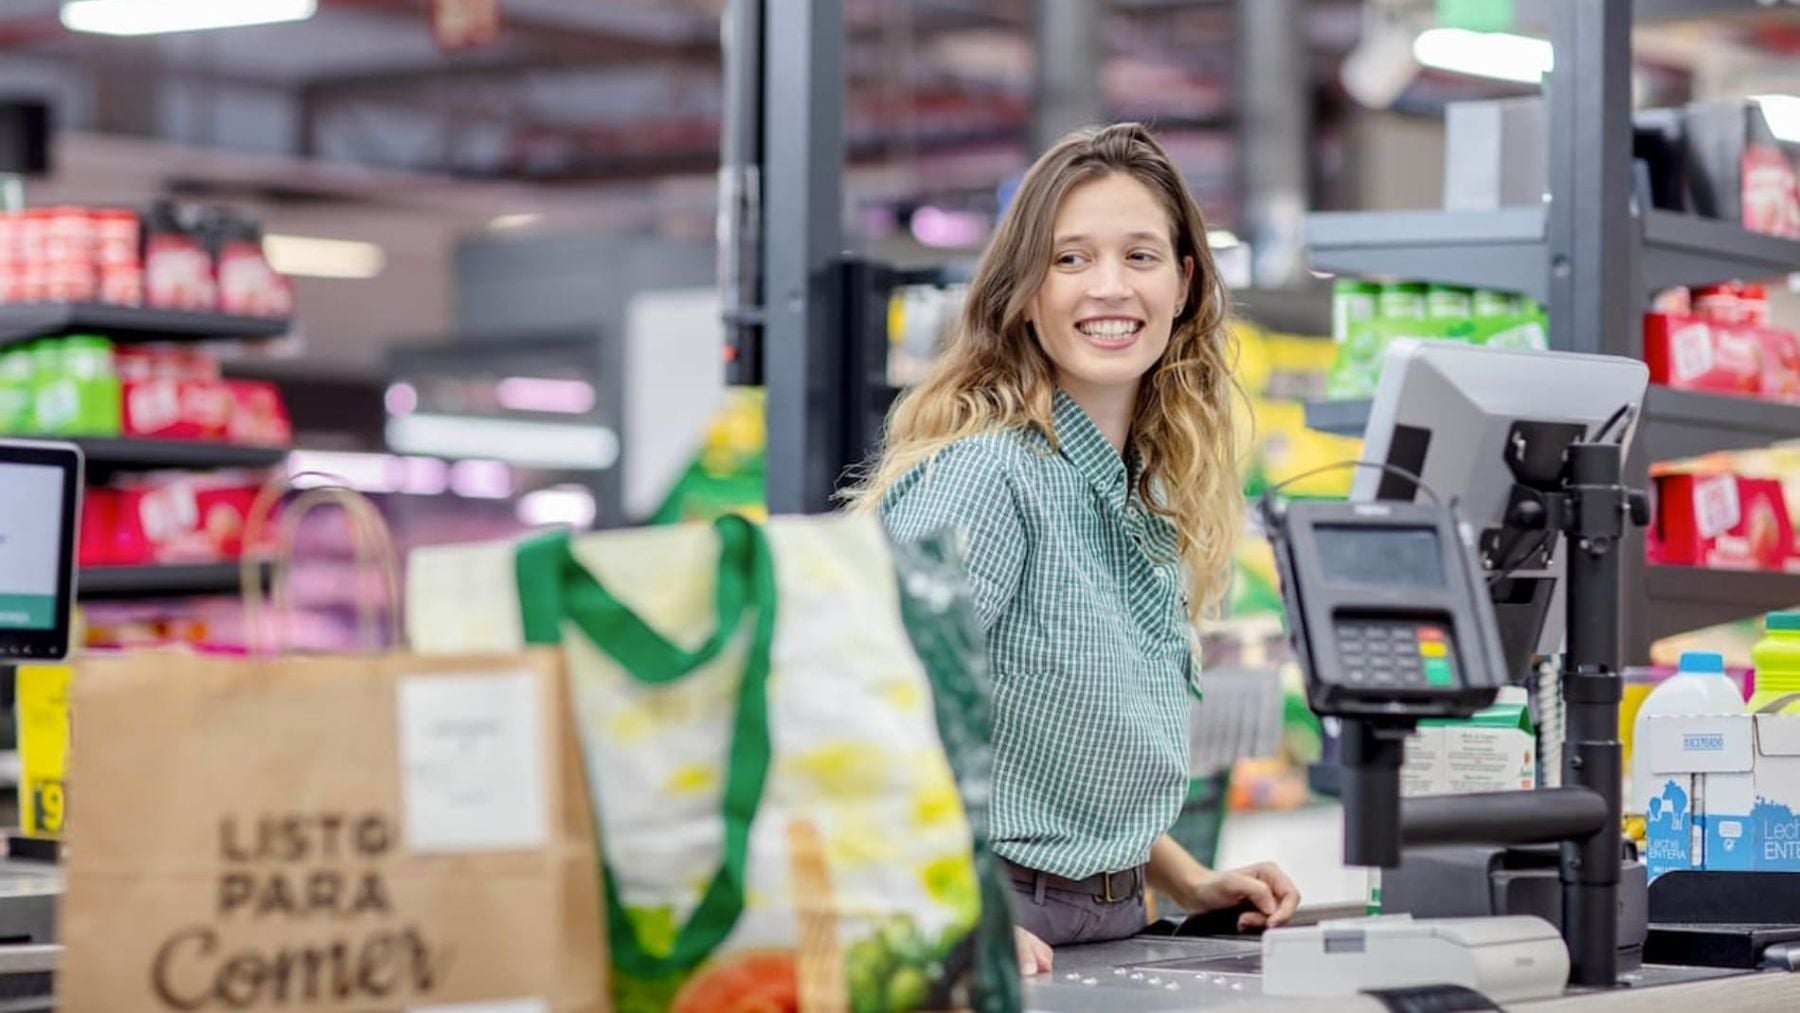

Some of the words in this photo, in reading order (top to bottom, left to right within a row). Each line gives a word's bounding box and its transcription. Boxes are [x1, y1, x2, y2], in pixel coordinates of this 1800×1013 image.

[218, 814, 390, 862] LISTO
[1648, 849, 1687, 860] ENTERA
[217, 871, 392, 919] PARA
[151, 921, 446, 1012] Comer
